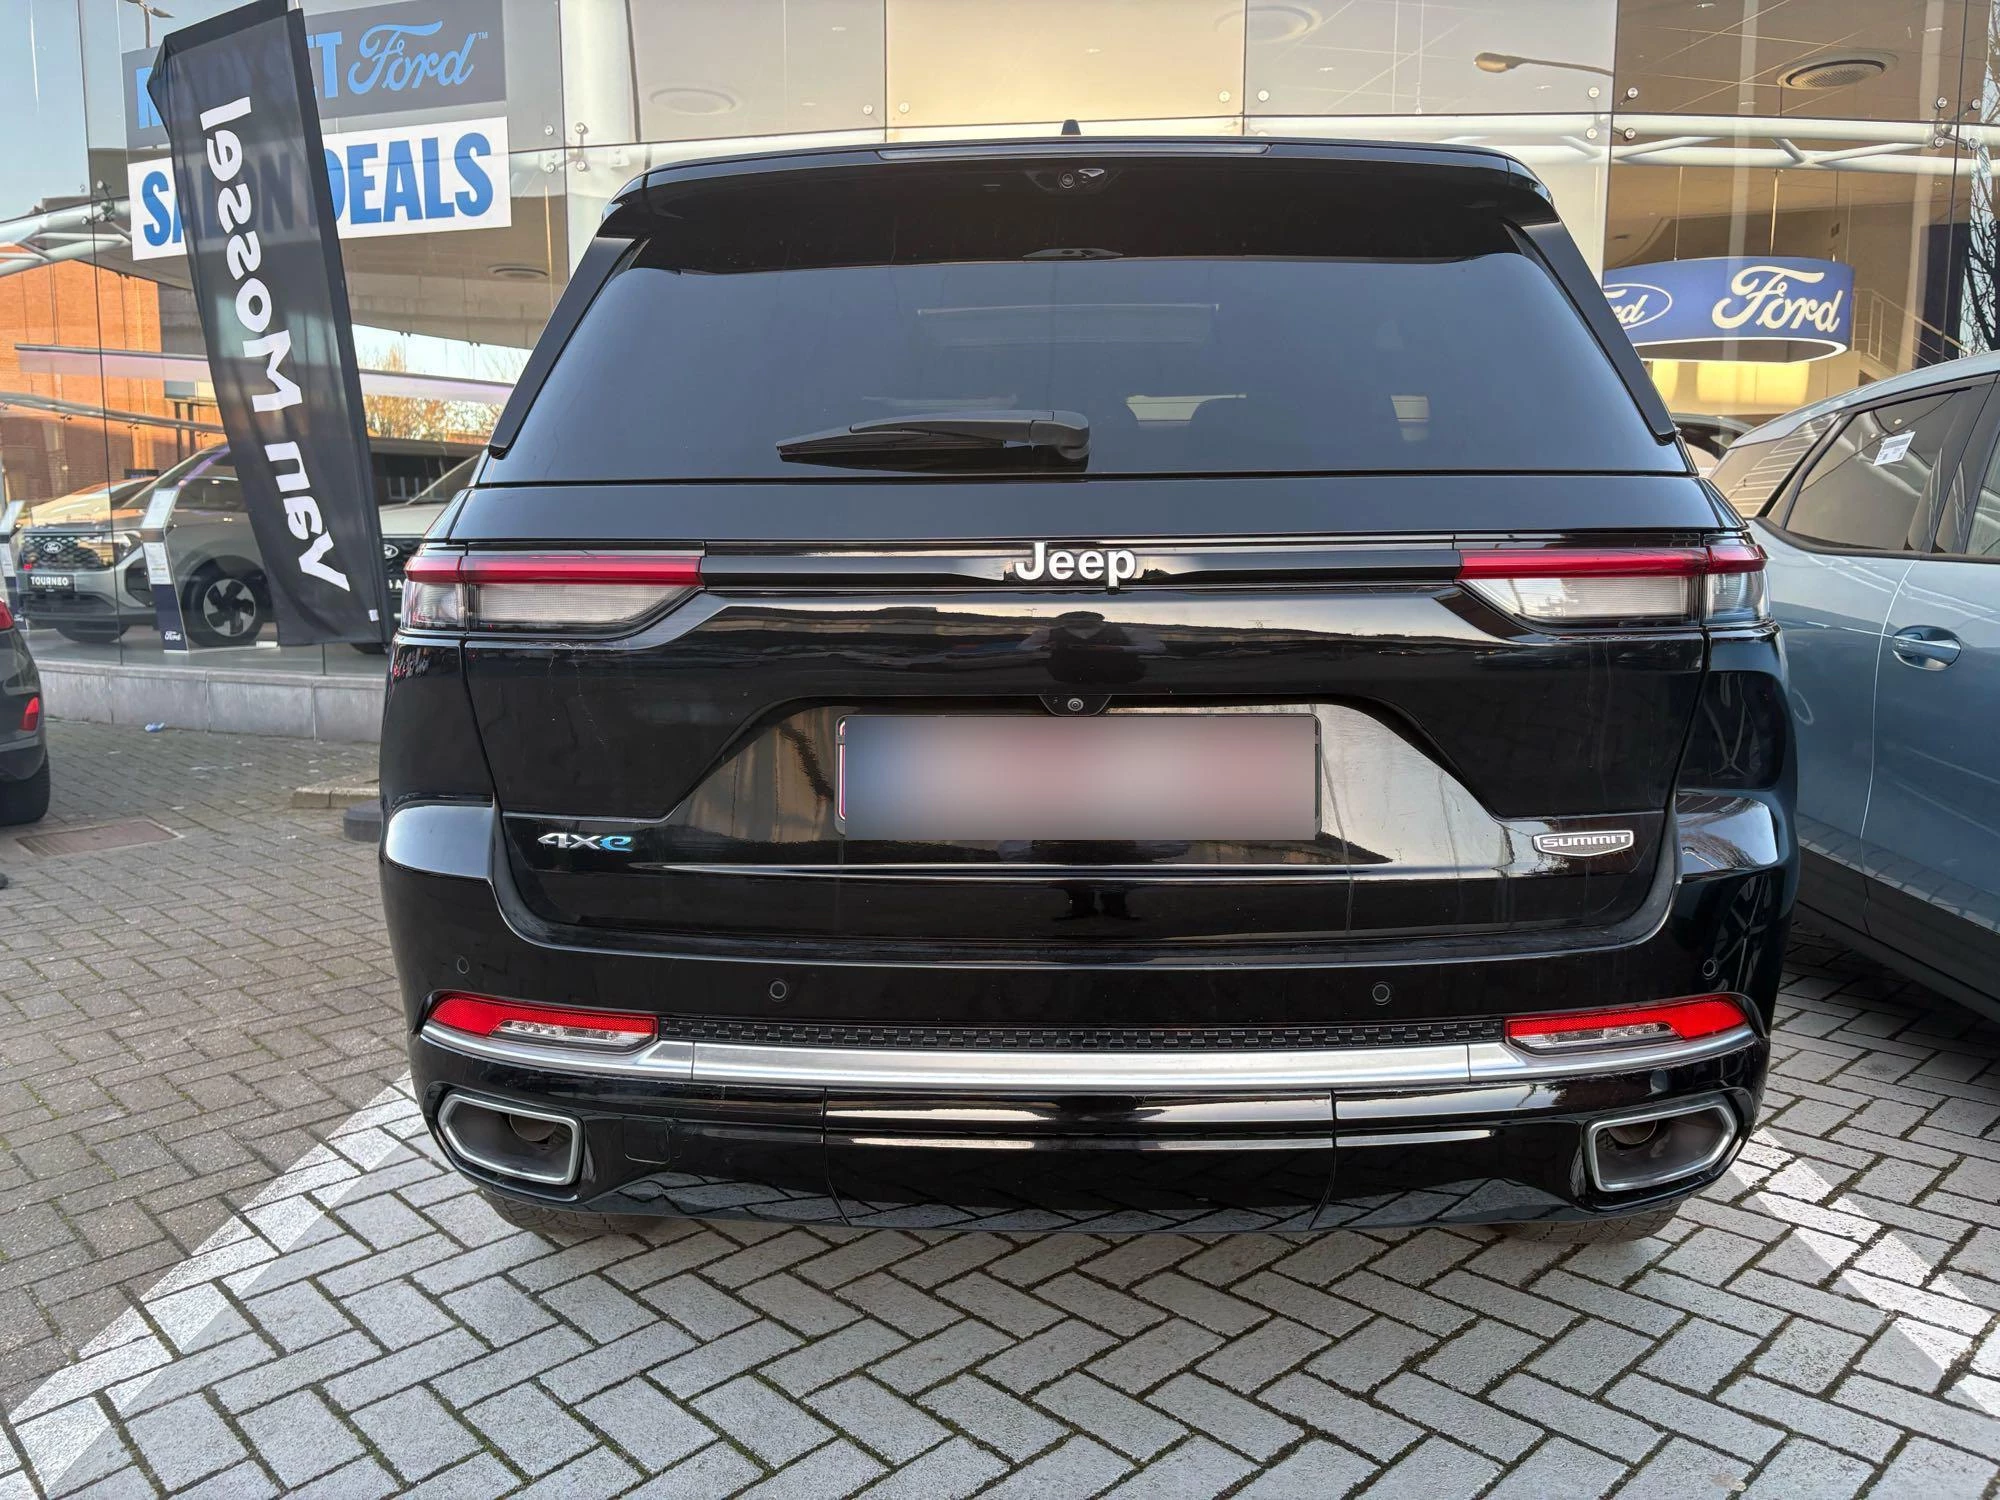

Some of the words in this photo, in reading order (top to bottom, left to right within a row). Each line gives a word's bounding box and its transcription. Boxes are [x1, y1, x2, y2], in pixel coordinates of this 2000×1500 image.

[347, 20, 477, 95] Ford
[1711, 265, 1844, 333] Ford
[30, 576, 69, 586] TOURNEO
[1015, 541, 1136, 587] Jeep
[1542, 833, 1630, 848] SUMMIT
